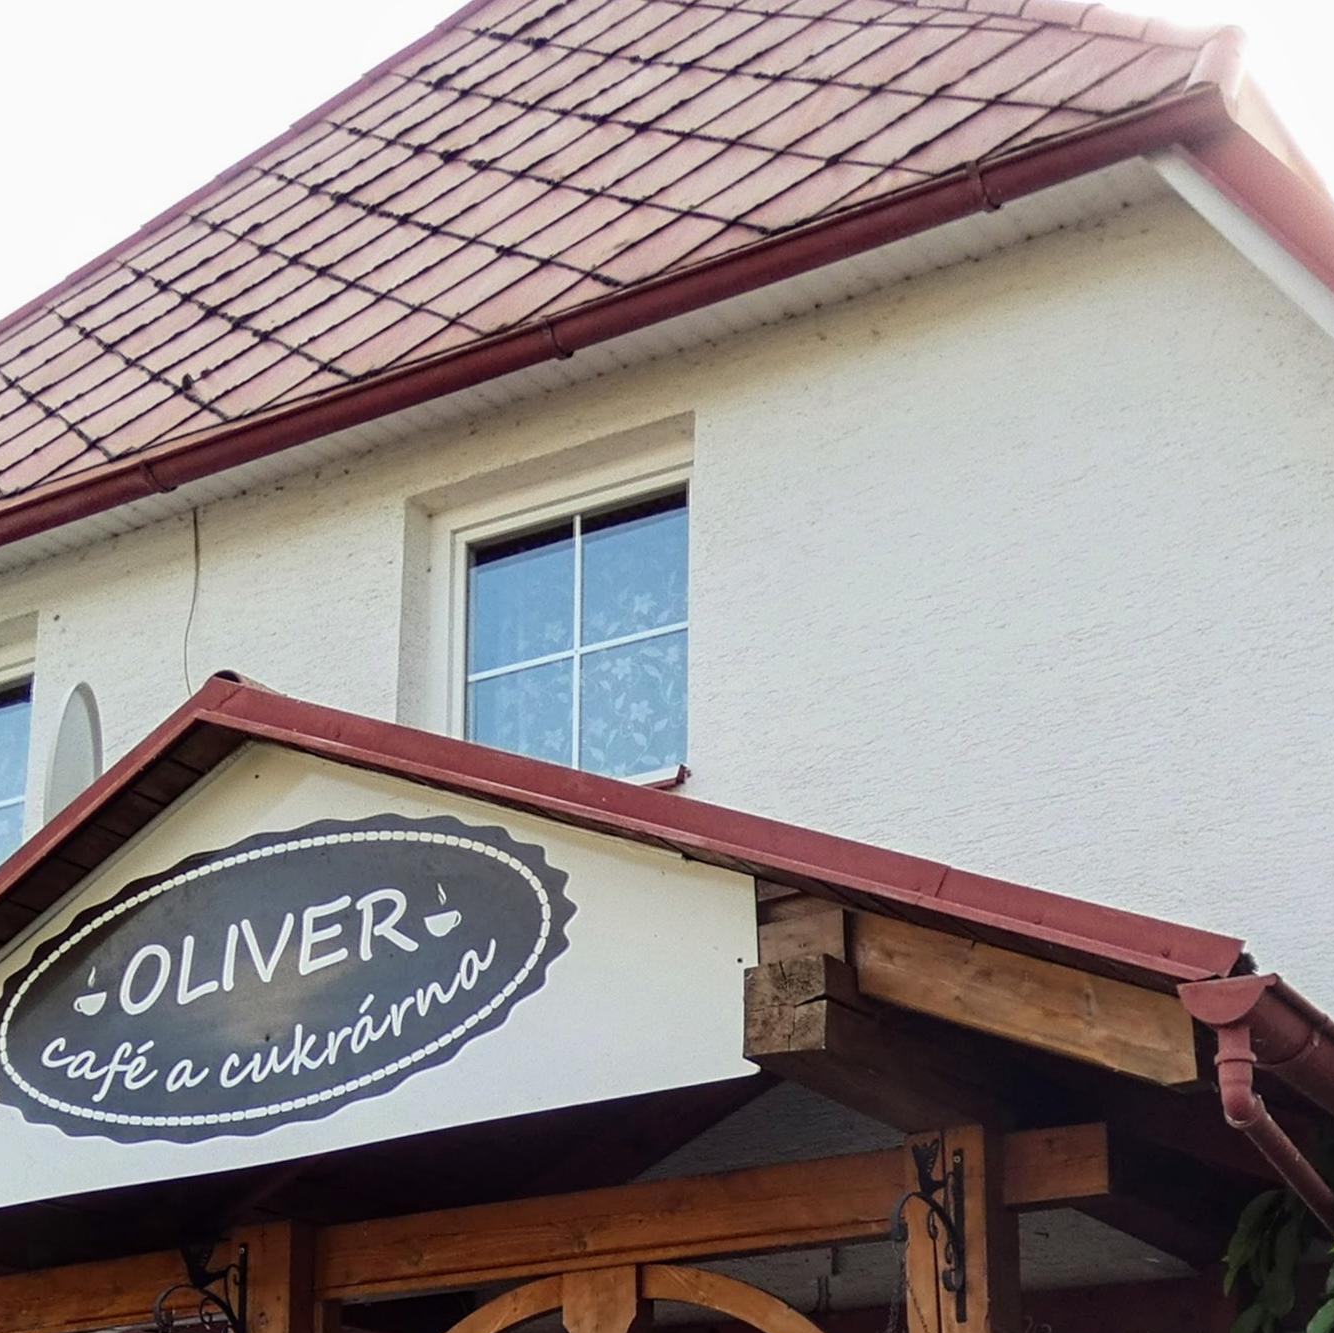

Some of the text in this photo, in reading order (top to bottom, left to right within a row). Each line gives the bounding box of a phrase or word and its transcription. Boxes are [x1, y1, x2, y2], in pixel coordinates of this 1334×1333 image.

[41, 937, 497, 1103] café a cukrárna
[119, 888, 420, 1016] OLIVER
